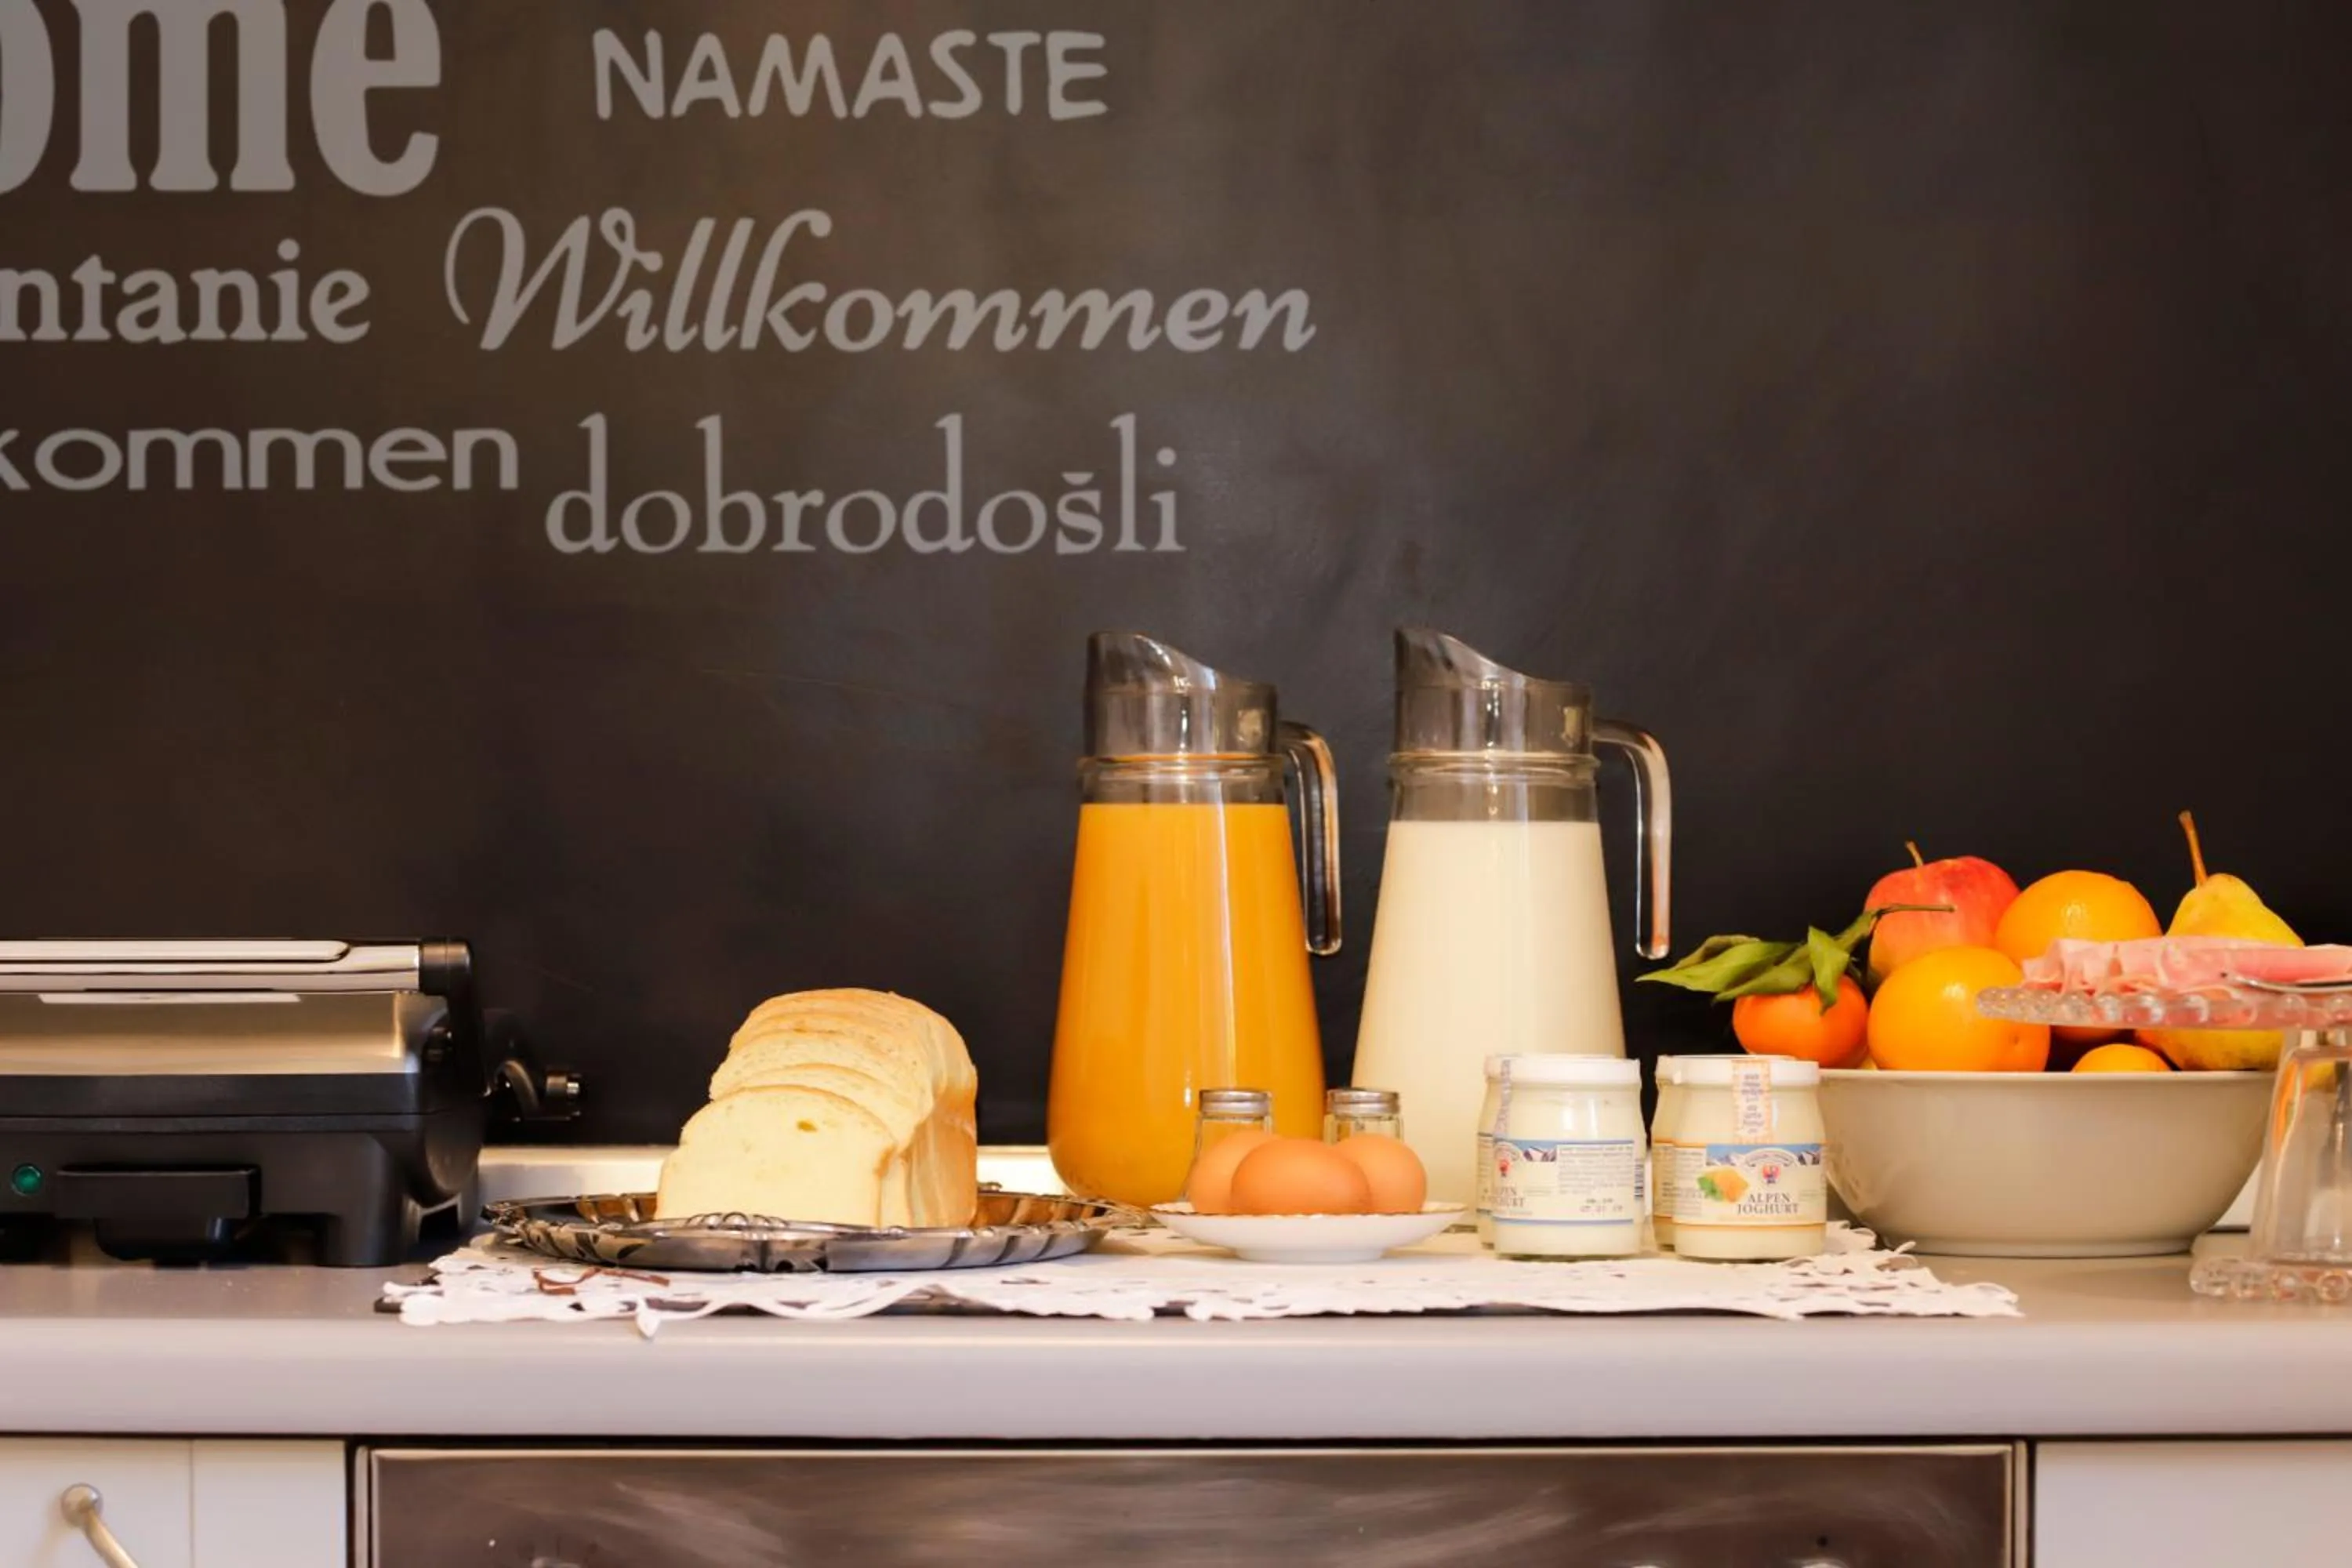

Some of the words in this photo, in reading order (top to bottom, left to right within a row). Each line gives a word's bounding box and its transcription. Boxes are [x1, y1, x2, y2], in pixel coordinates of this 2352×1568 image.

[593, 28, 1109, 121] NAMASTE
[445, 207, 1316, 353] Willkommen
[546, 411, 1187, 555] dobrodošli
[1737, 1203, 1799, 1215] JOGHURT
[1748, 1192, 1791, 1203] ALPEN
